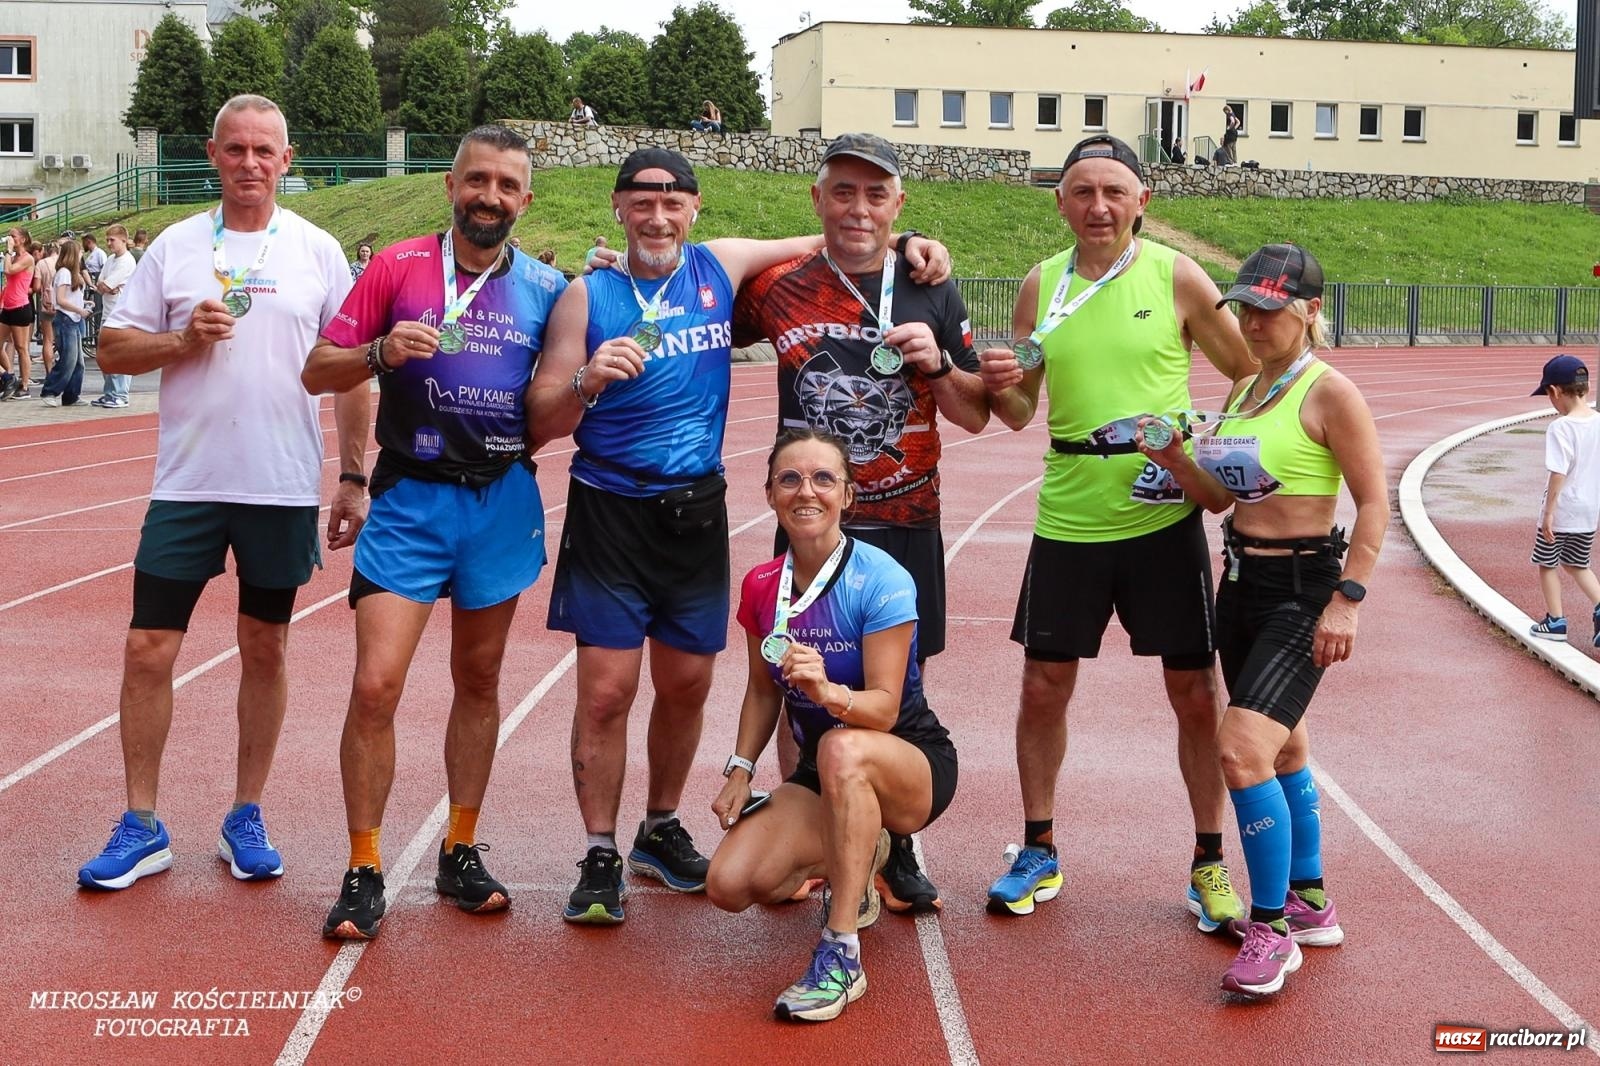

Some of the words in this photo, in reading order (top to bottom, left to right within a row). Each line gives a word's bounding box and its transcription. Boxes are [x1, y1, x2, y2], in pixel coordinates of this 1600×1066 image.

[134, 29, 151, 49] D
[243, 278, 278, 286] ystans
[244, 286, 278, 294] BOMIA
[476, 309, 485, 320] &
[488, 311, 514, 326] FUN
[1133, 309, 1153, 319] 4F
[463, 322, 500, 340] ESIA
[776, 322, 882, 354] GRUBIO
[464, 341, 502, 356] YBNIK
[458, 385, 480, 401] PW
[1215, 465, 1246, 487] 157
[787, 628, 799, 637] UN
[802, 627, 808, 637] &
[810, 628, 832, 638] FUN
